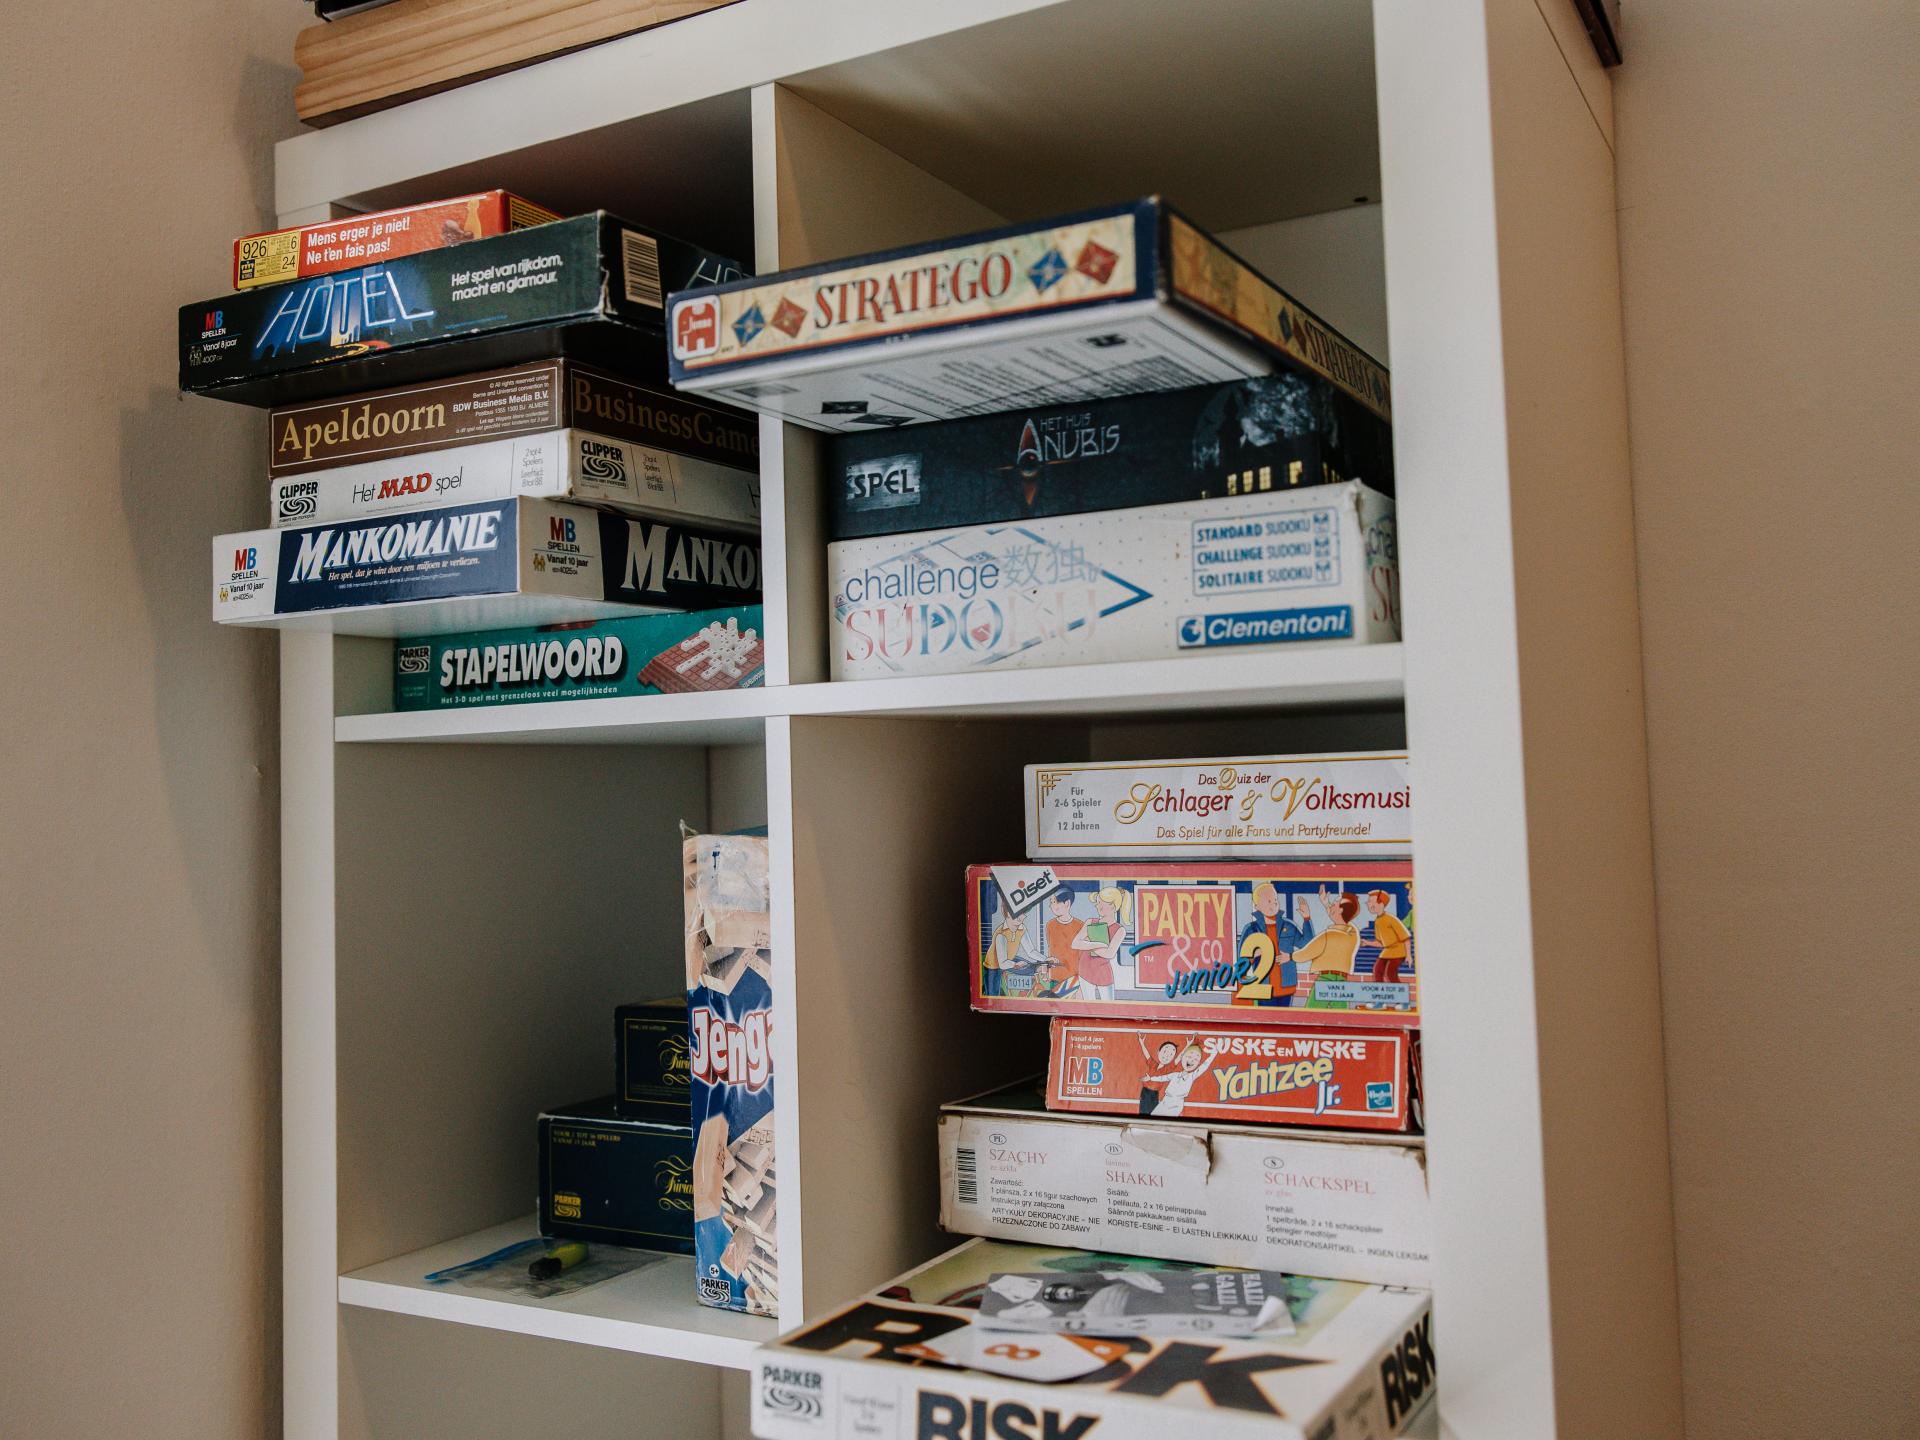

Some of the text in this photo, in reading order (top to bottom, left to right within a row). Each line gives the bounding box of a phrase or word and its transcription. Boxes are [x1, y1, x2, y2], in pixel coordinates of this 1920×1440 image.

[291, 236, 296, 249] 6
[308, 216, 410, 247] Mens erger je niet!
[243, 240, 266, 260] 926
[306, 240, 390, 265] Ne t'en fais pas!
[451, 255, 563, 287] Het spel van rijkdom,
[452, 271, 558, 301] macht en glamour.
[814, 251, 1013, 329] STRATEGO
[256, 270, 434, 348] HOTEL
[206, 311, 223, 330] MB
[202, 328, 227, 339] SPELLEN
[203, 339, 237, 351] Vanaf jaar
[1304, 319, 1371, 400] STRATEGO
[453, 390, 548, 412] BDW Business Media B.V.
[278, 403, 445, 460] Apeldoorn
[1040, 417, 1062, 431] HET
[581, 440, 623, 462] CLIPPER
[1017, 417, 1120, 465] ANUBIS
[280, 482, 318, 499] CLIPPER
[353, 466, 463, 504] Het MAD spel
[854, 469, 914, 498] SPEL
[551, 516, 576, 542] MB
[1197, 519, 1311, 542] STANDARD SUDOKU
[288, 511, 501, 583] MANKOMANIE
[548, 541, 579, 552] SPELLEN
[620, 519, 762, 593] MANKO
[1197, 543, 1311, 565] CHALLENGE SUDOKU
[235, 548, 256, 571] MB
[547, 554, 567, 564] Vanaf
[576, 558, 588, 567] jaar
[232, 570, 258, 580] SPELLEN
[328, 572, 340, 581] Het
[341, 570, 354, 580] spel,
[355, 569, 365, 578] dat
[366, 568, 372, 578] je
[388, 565, 402, 574] door
[416, 561, 440, 571] miljoen
[846, 562, 1000, 602] challenge
[1199, 567, 1312, 588] SOLITAIRE SUDOKU
[230, 583, 264, 592] Vanaf jaar
[845, 588, 1100, 661] SUDOKU
[1208, 610, 1347, 640] Clementoni
[400, 647, 429, 658] PARKER
[440, 636, 623, 687] STAPELWOORD
[468, 695, 483, 704] spel
[501, 692, 540, 701] grenzeloos
[561, 687, 617, 697] mogelijkheden
[1199, 768, 1271, 790] Das Quiz der
[1071, 787, 1084, 796] Für
[1113, 777, 1411, 825] Schlager & Volksmusi
[1055, 799, 1101, 809] 2-6 Spieler
[1073, 810, 1083, 818] ab
[1058, 822, 1100, 831] 12 Jahren
[1157, 823, 1371, 841] Das Spiel für alle Fans und Partyfreunde!
[1010, 871, 1052, 906] Diset
[1143, 892, 1230, 938] PARTY
[1167, 934, 1222, 977] & CO
[1235, 932, 1275, 999] 2
[1009, 977, 1030, 987] 10114
[1203, 1037, 1366, 1060] SUSKE EN WISKE
[1068, 1057, 1103, 1086] MB
[1213, 1057, 1334, 1102] Yahtzee
[1067, 1087, 1102, 1095] SPELLEN
[989, 1149, 1047, 1165] SZACHY
[1106, 1170, 1164, 1187] SHAKKI
[1264, 1172, 1376, 1195] SCHACKSPEL
[554, 1194, 581, 1206] PARKER
[1034, 1201, 1065, 1209] załączona
[1060, 1194, 1097, 1203] szachowych
[1113, 1199, 1141, 1209] pelilauta,
[1165, 1205, 1206, 1216] pelinappulaa
[992, 1207, 1025, 1217] ARTYKUŁY
[1028, 1211, 1079, 1222] DEKORACYJNE
[993, 1217, 1047, 1228] PRZEZNACZONE
[1062, 1223, 1090, 1232] ZABAWY
[1107, 1208, 1174, 1222] Säännöt pakkauksen
[1107, 1219, 1164, 1231] KORISTE-ESINE
[1182, 1227, 1211, 1237] LASTEN
[1213, 1232, 1258, 1242] LEIKKIKALU
[1266, 1225, 1302, 1236] Spelregler
[1267, 1236, 1429, 1261] DEKORATIONSARTIKEL INGEN LEKSAK
[711, 1265, 719, 1274] 5+
[701, 1278, 730, 1292] PARKER
[763, 1366, 822, 1389] PARKER
[1381, 1310, 1436, 1429] RISK
[917, 1389, 1100, 1440] RISK
